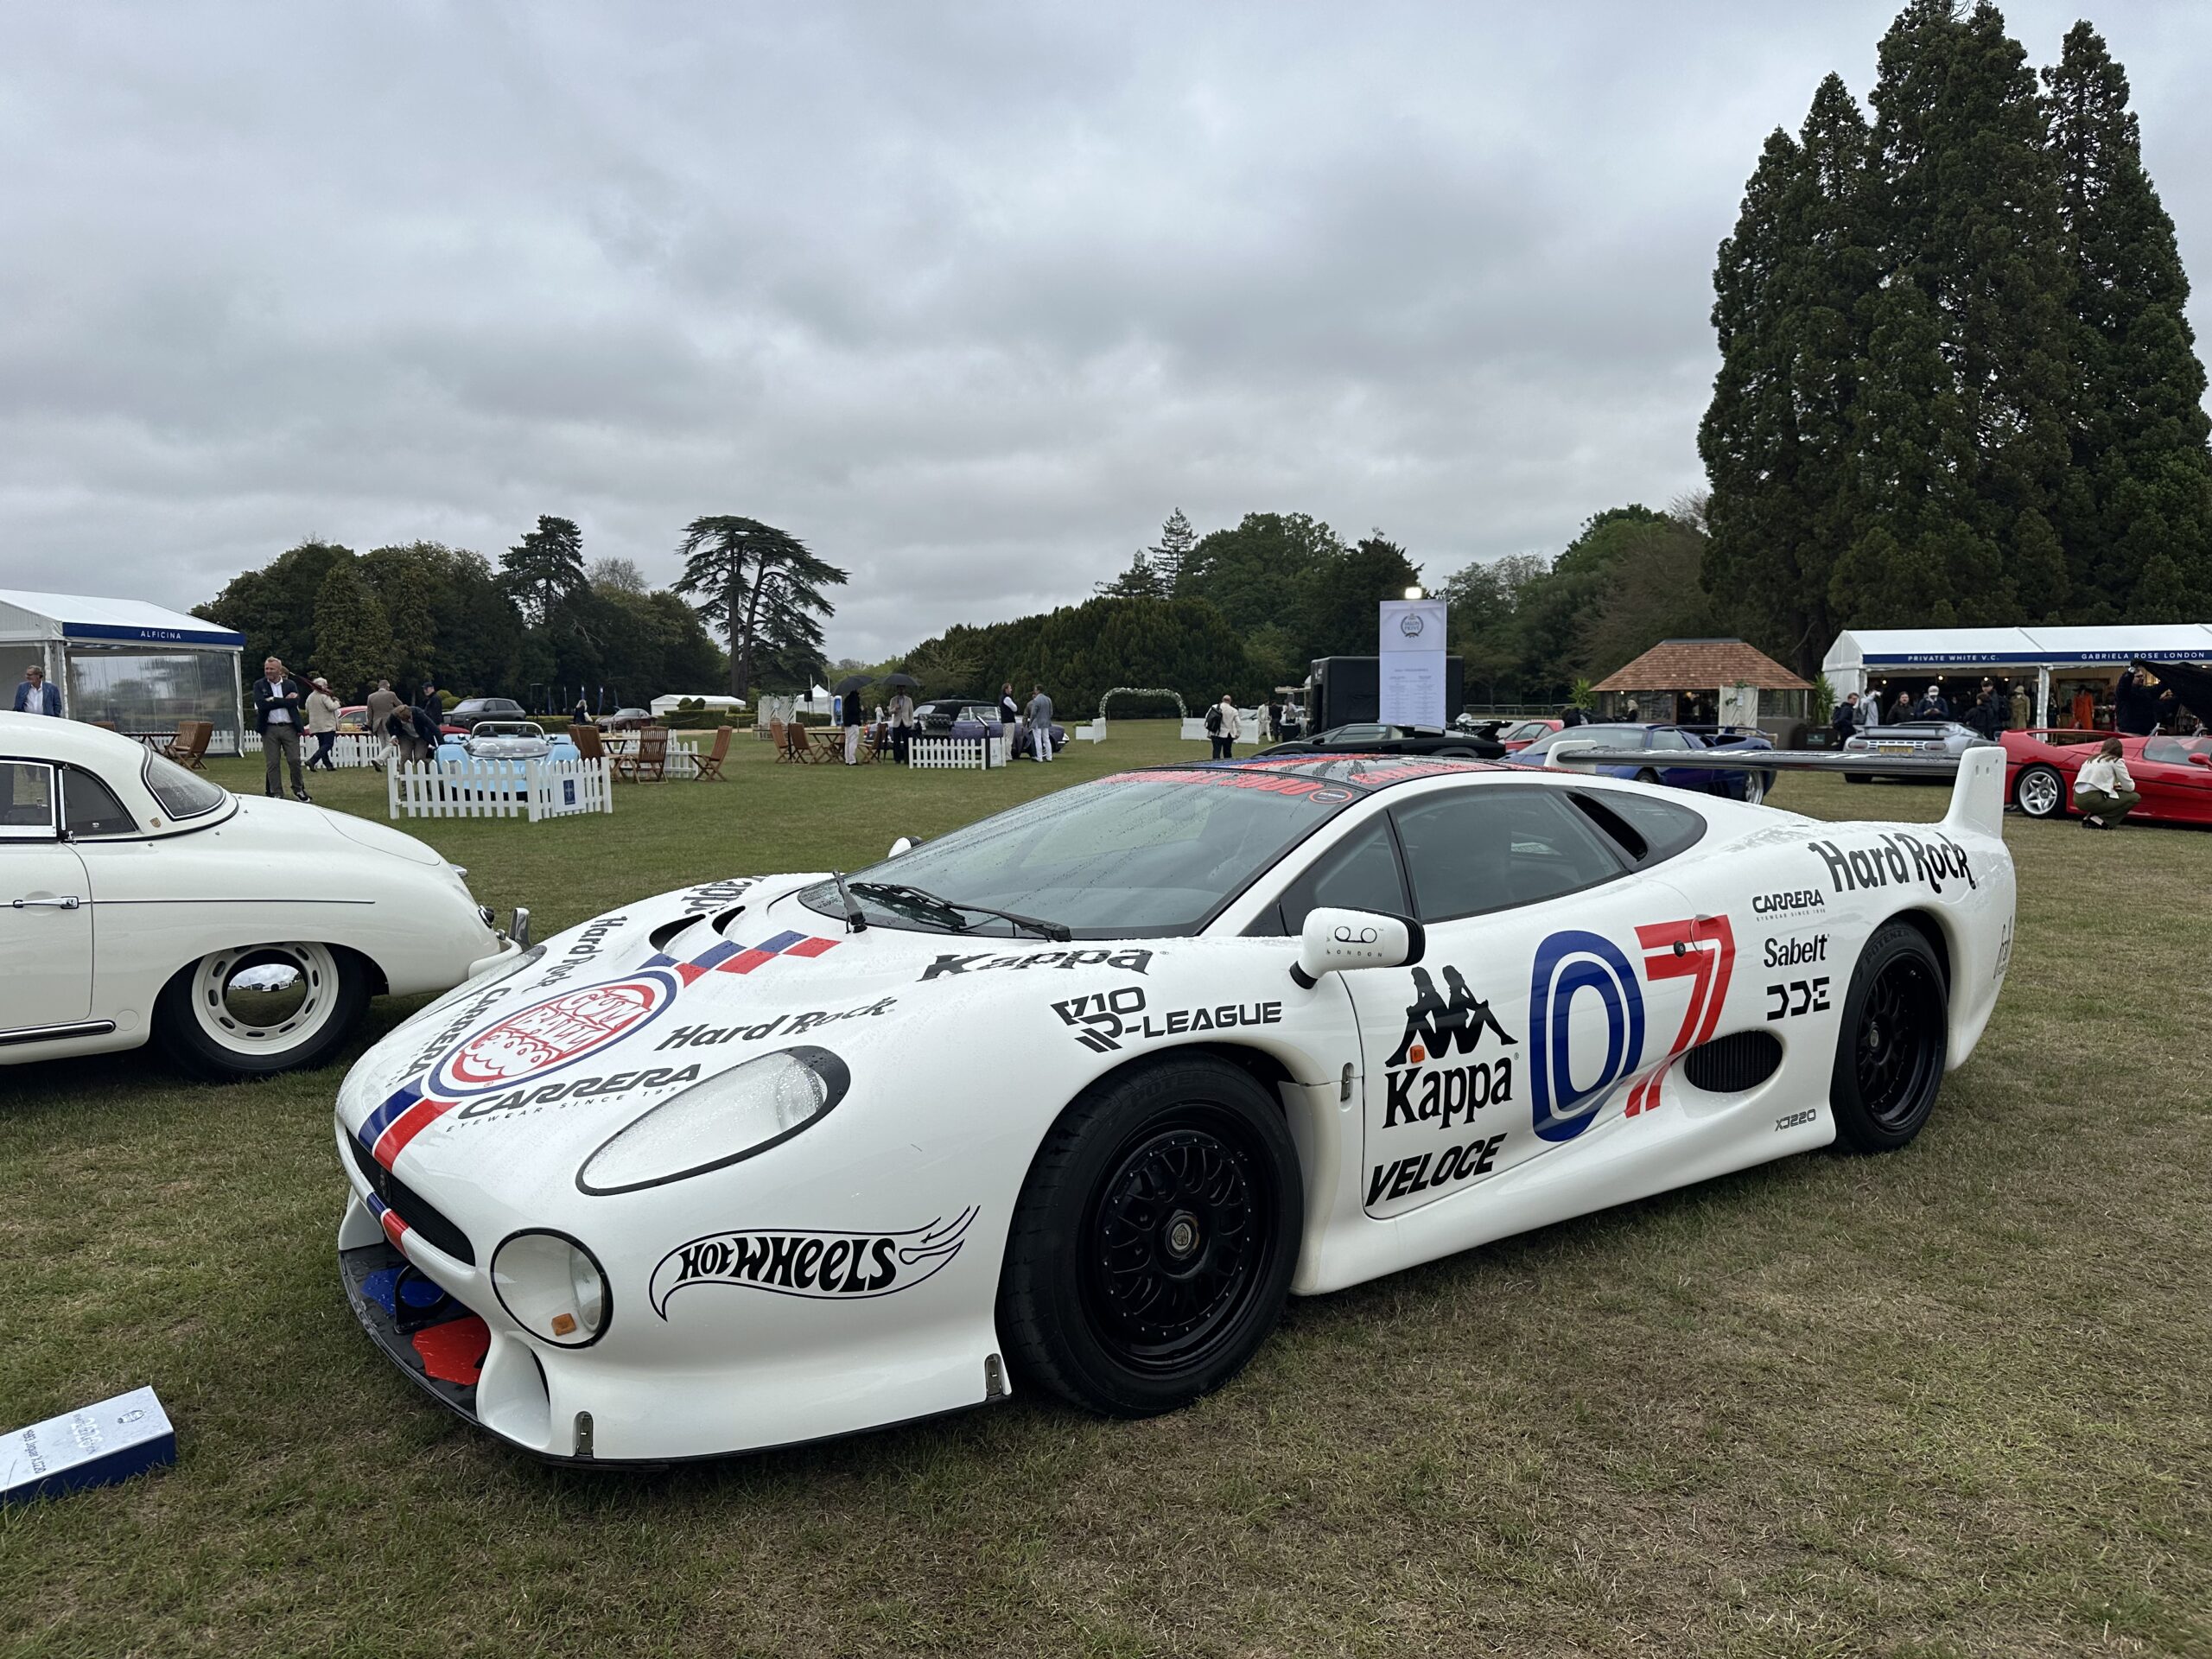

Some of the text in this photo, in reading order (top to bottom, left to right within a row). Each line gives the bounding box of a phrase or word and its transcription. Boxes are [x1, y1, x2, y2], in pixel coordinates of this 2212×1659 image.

[141, 630, 181, 639] ALFICINA
[1808, 831, 1978, 894] Hard Rock
[1752, 889, 1825, 913] CARRERA
[1756, 913, 1787, 922] EYEWEAR
[521, 916, 628, 994] Hard Rock
[915, 949, 1154, 982] Kappa
[1326, 949, 1382, 957] LONDON
[1764, 934, 1828, 968] Sabelt
[397, 987, 512, 1084] CARRERA
[653, 996, 898, 1051] Hard Rock
[1529, 914, 1736, 1142] 07
[445, 1107, 543, 1133] EYEWEAR
[561, 1094, 625, 1109] SINCE
[458, 1063, 702, 1119] CARRERA
[1382, 1057, 1513, 1130] Kappa
[1775, 1109, 1816, 1132] XJ220
[1364, 1133, 1508, 1207] VELOCE
